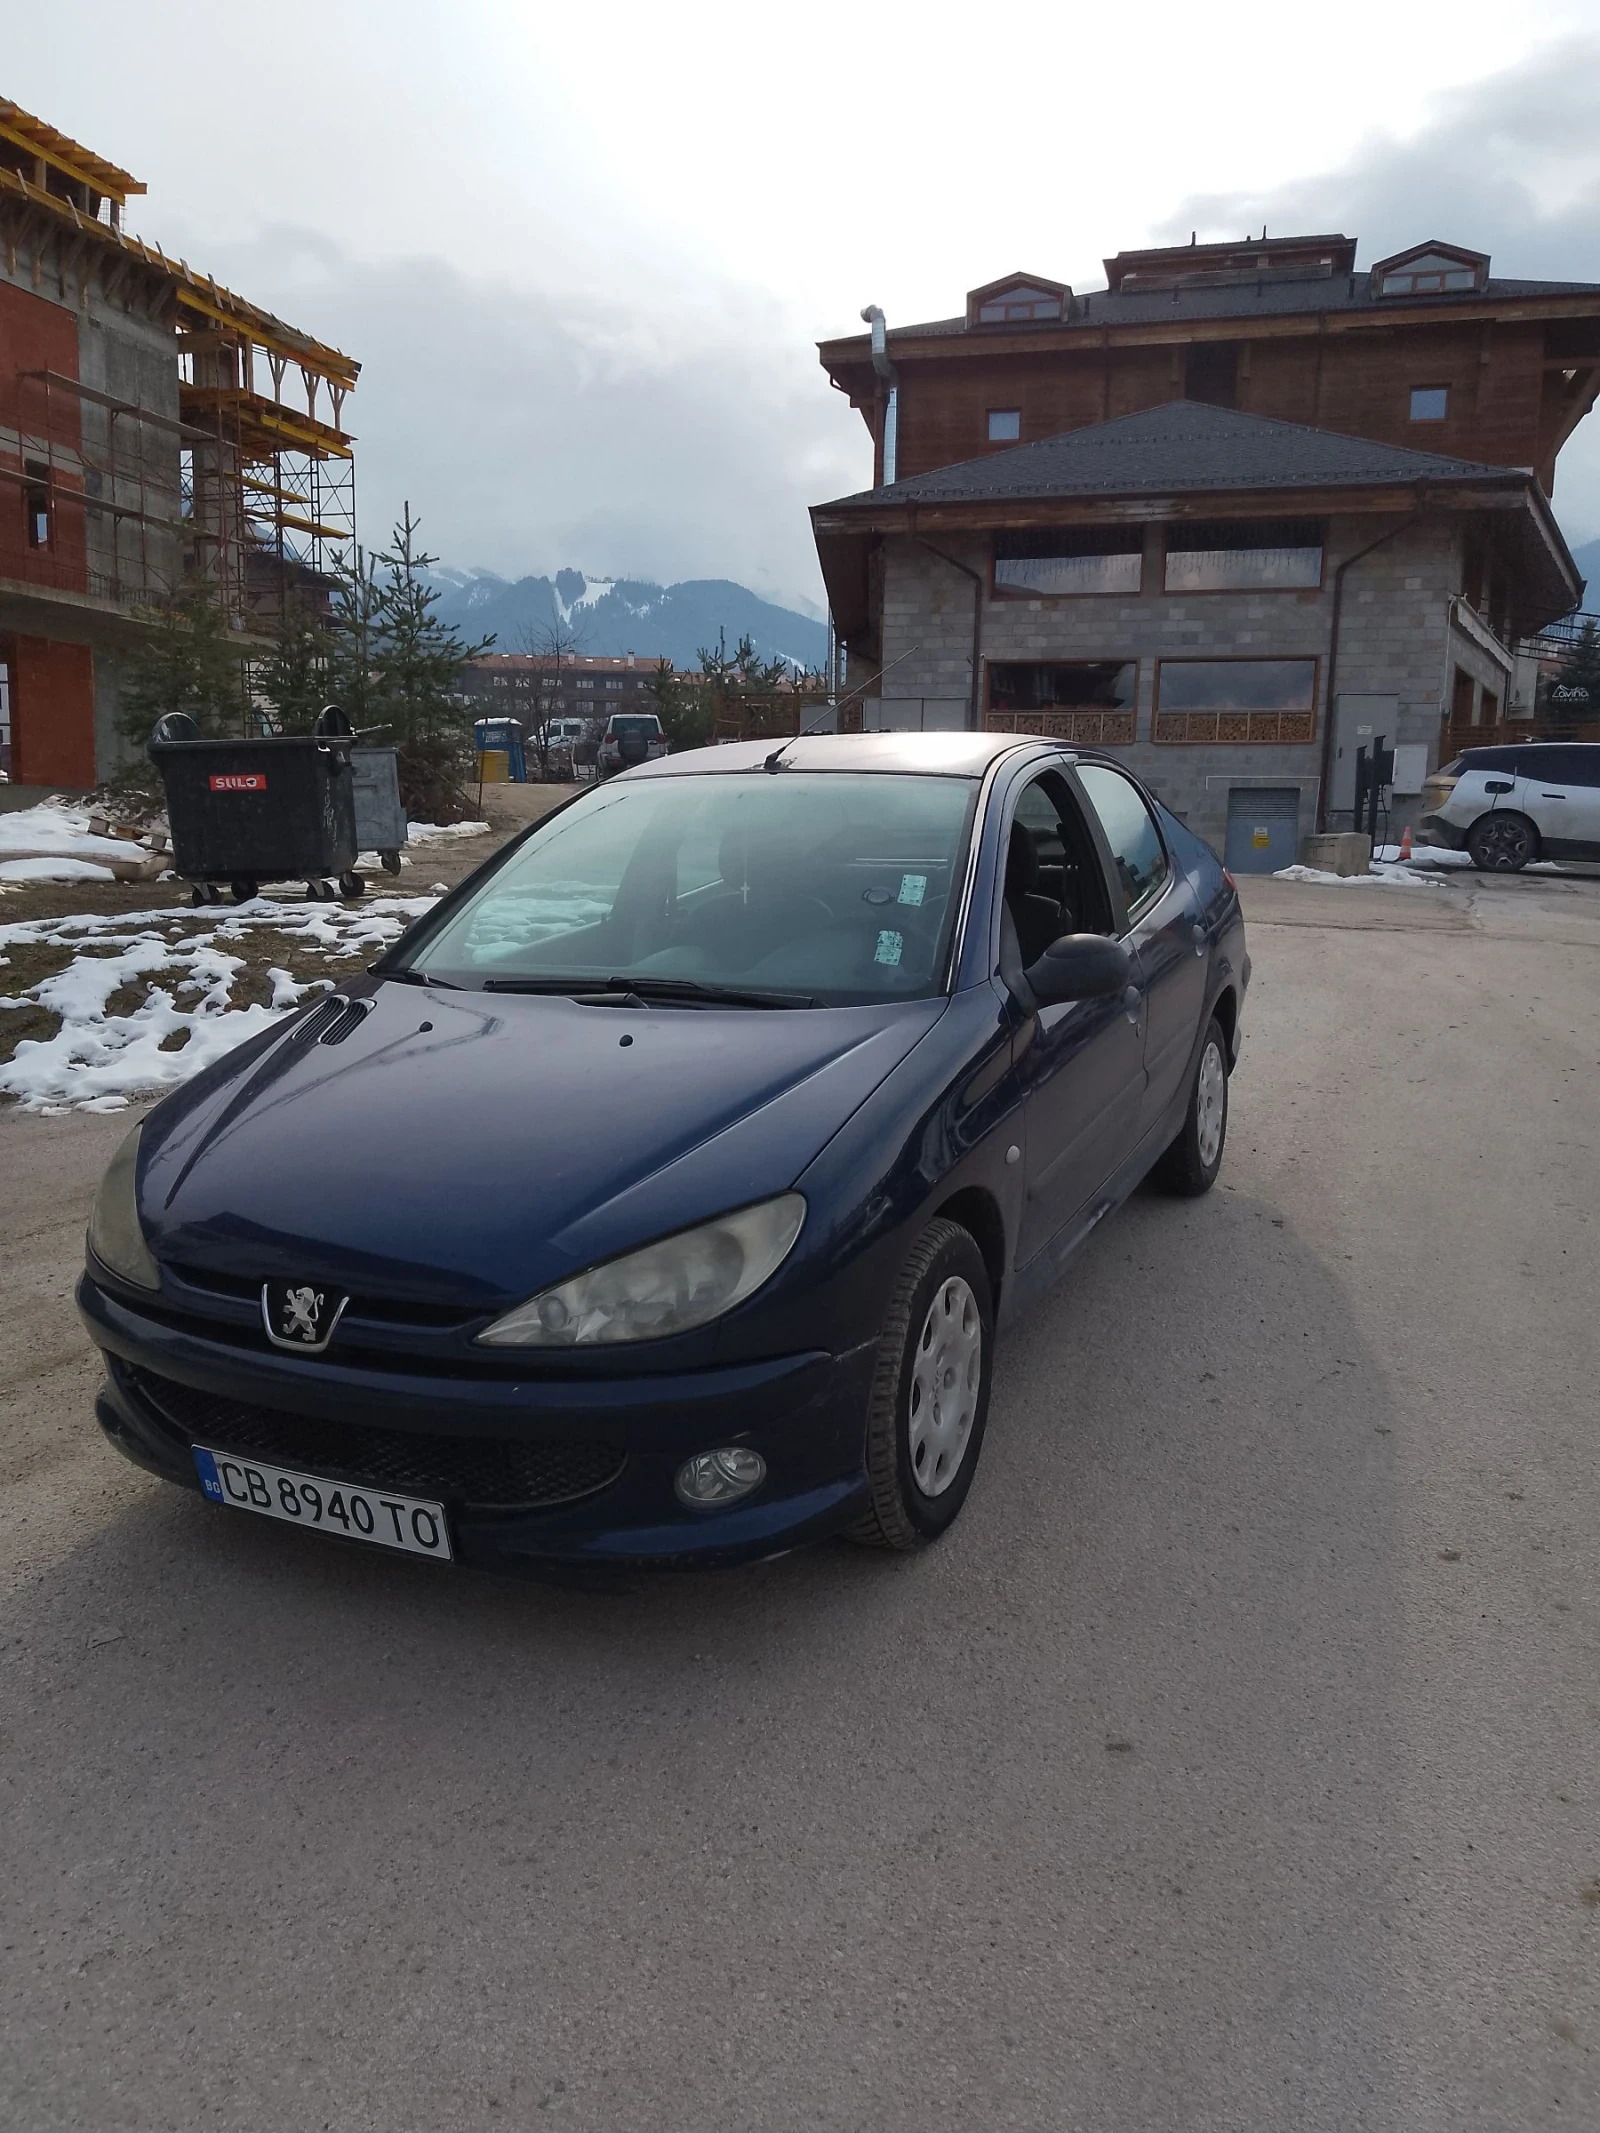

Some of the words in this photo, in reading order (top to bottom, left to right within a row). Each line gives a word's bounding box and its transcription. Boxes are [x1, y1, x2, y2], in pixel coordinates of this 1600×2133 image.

[215, 777, 257, 789] SULO
[205, 1479, 221, 1494] BG
[222, 1462, 272, 1508] CB
[277, 1477, 375, 1535] 8940
[380, 1500, 440, 1549] TO
